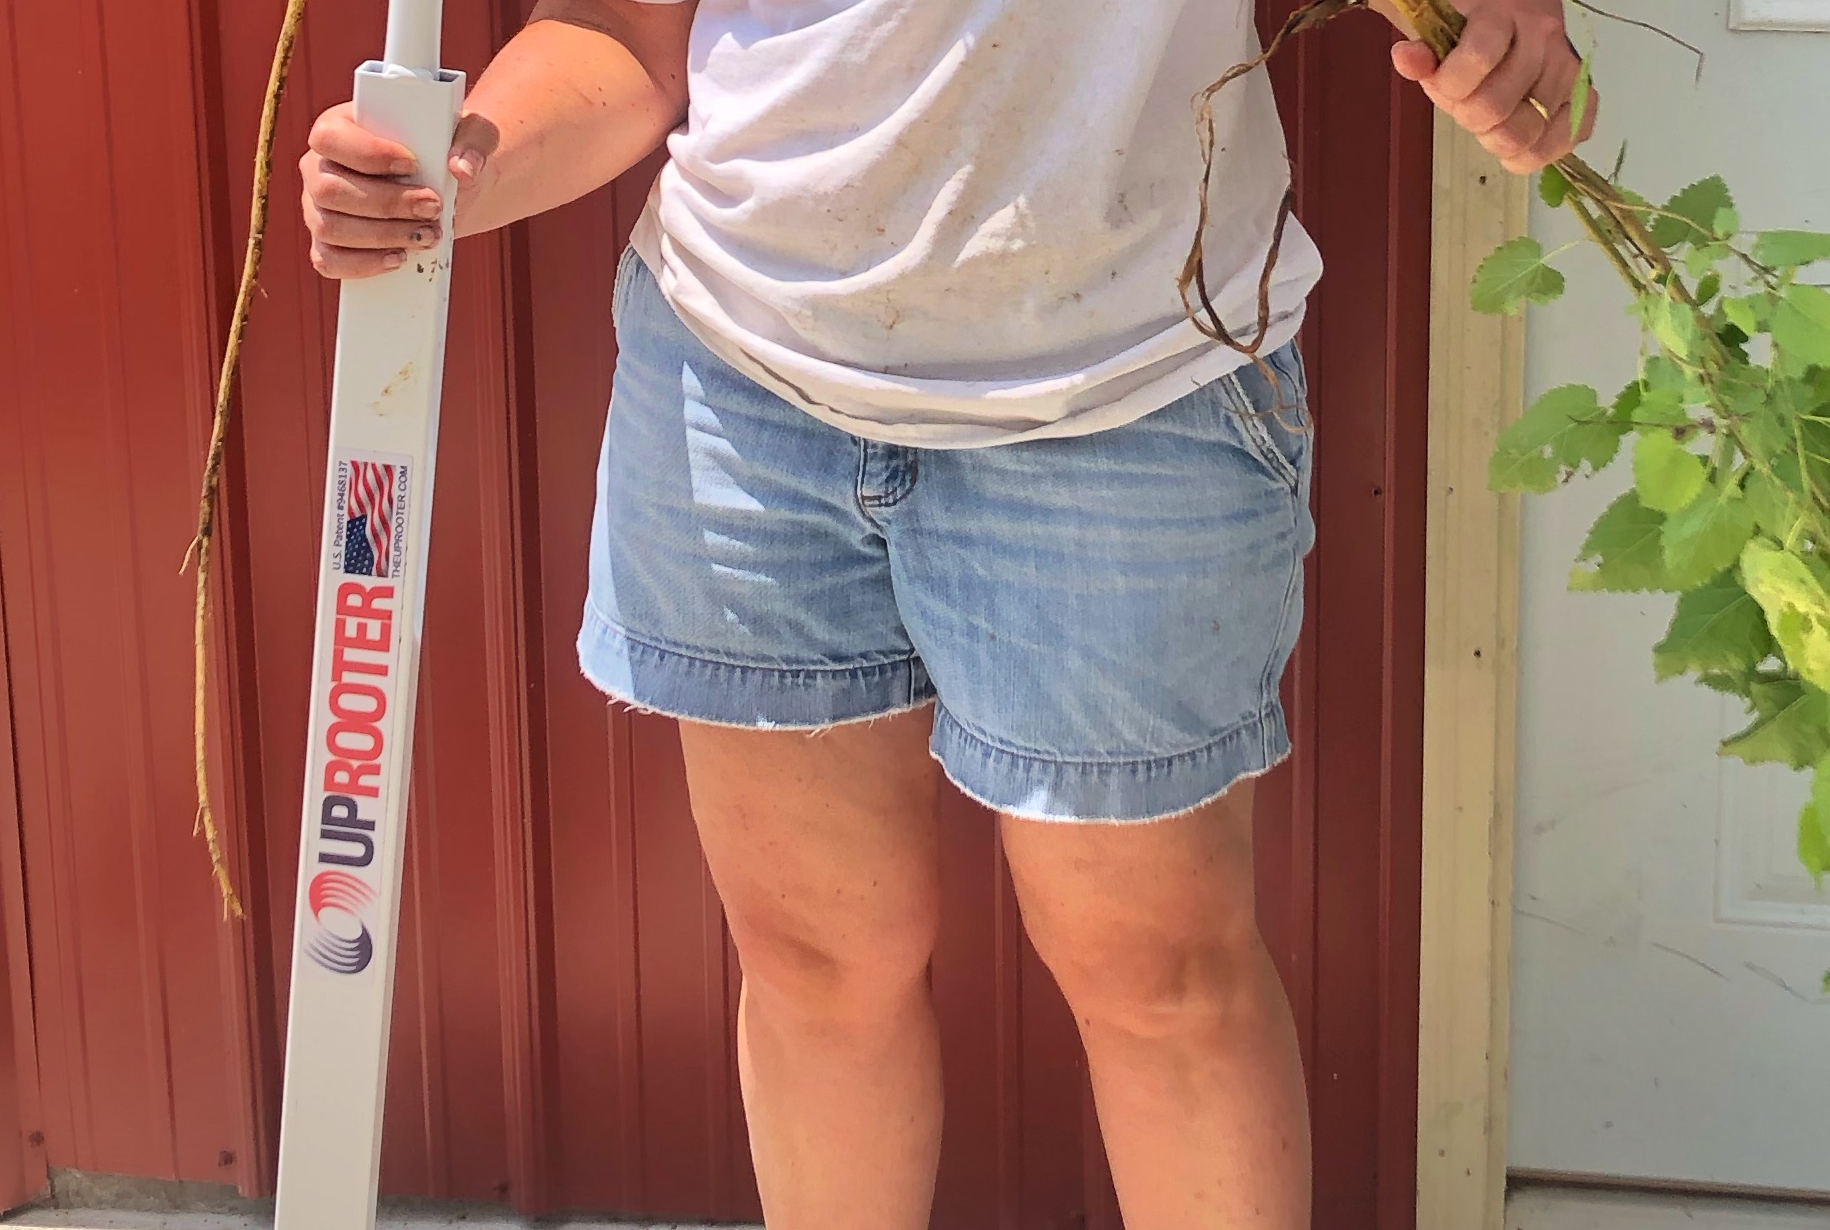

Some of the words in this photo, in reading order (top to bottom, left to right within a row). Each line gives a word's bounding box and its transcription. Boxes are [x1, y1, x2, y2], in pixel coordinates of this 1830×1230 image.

[333, 513, 345, 547] Patent
[391, 465, 408, 579] THEUPROOTER.COM
[318, 581, 395, 869] UPROOTER
